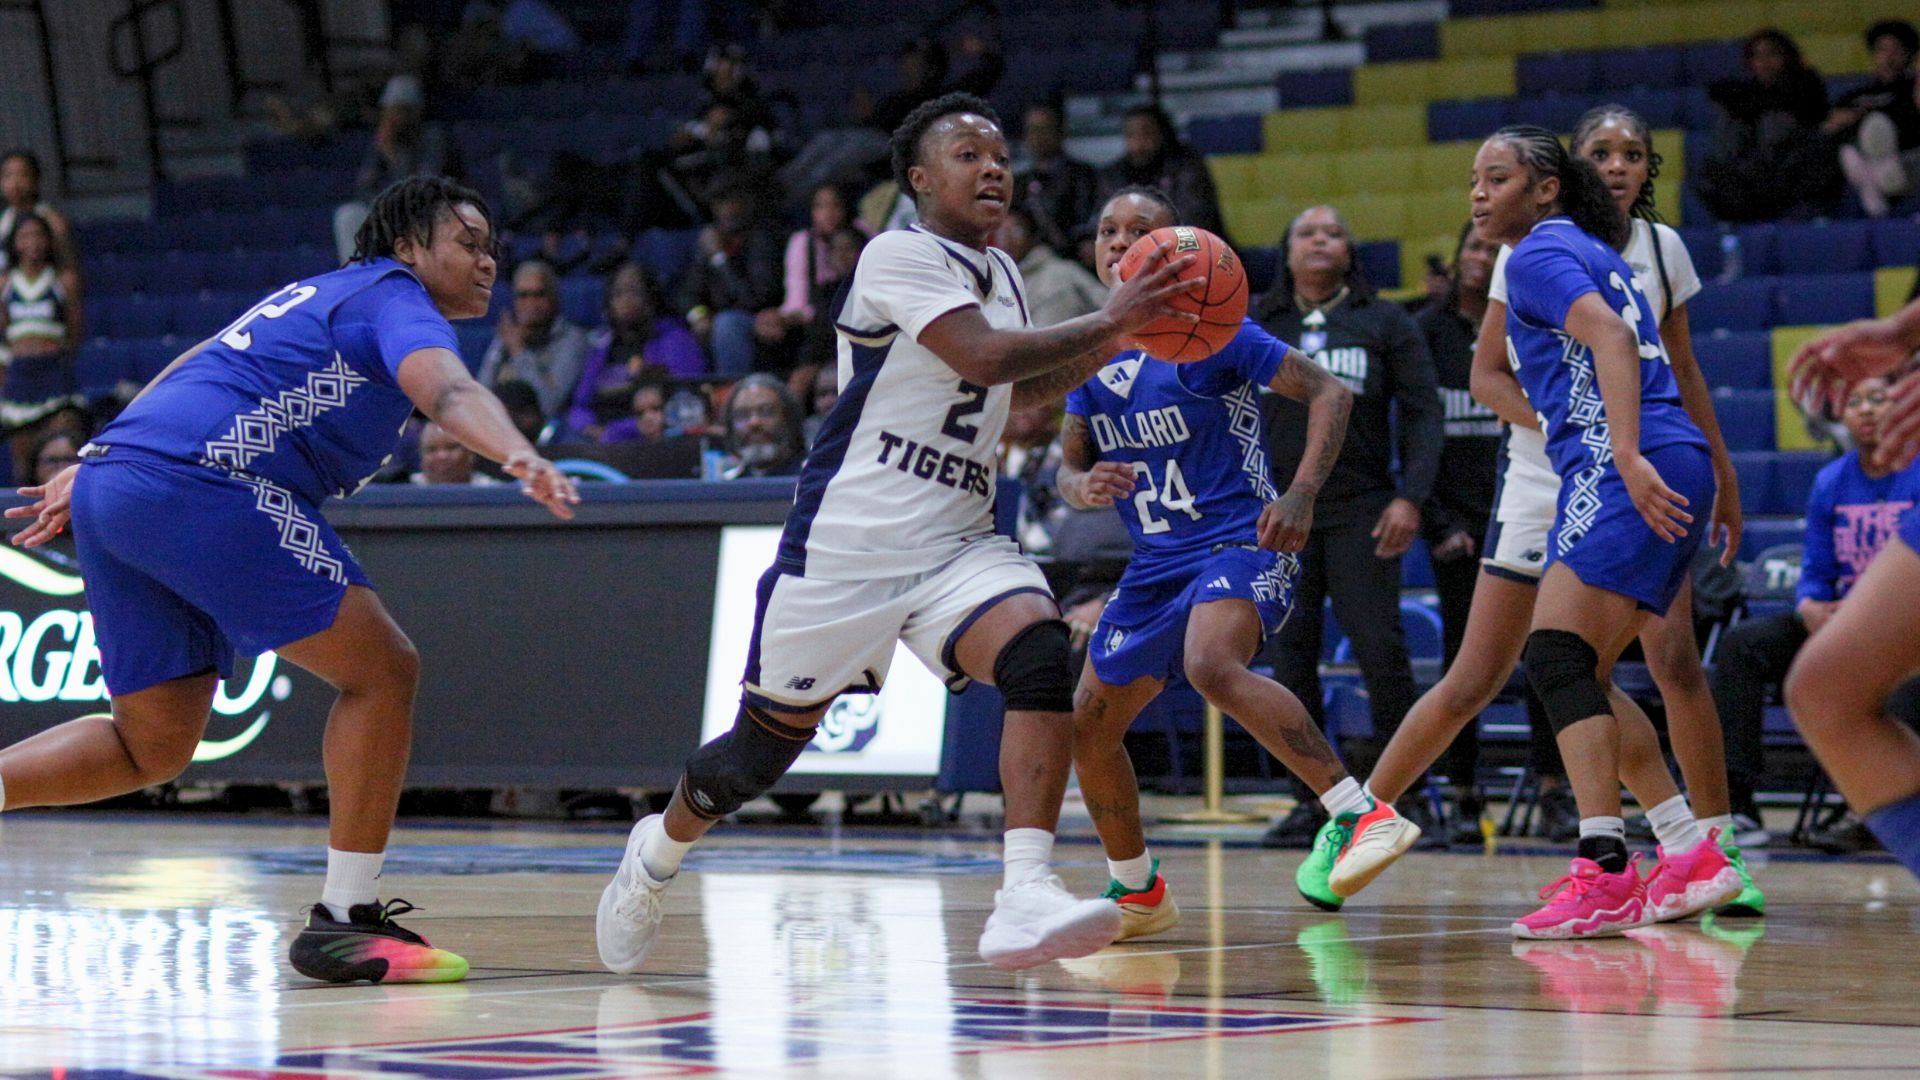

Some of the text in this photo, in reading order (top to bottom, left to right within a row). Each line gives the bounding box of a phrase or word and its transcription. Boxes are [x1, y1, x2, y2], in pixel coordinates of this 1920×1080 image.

[941, 379, 989, 446] 2
[877, 430, 990, 497] TIGERS
[1134, 459, 1203, 534] 24
